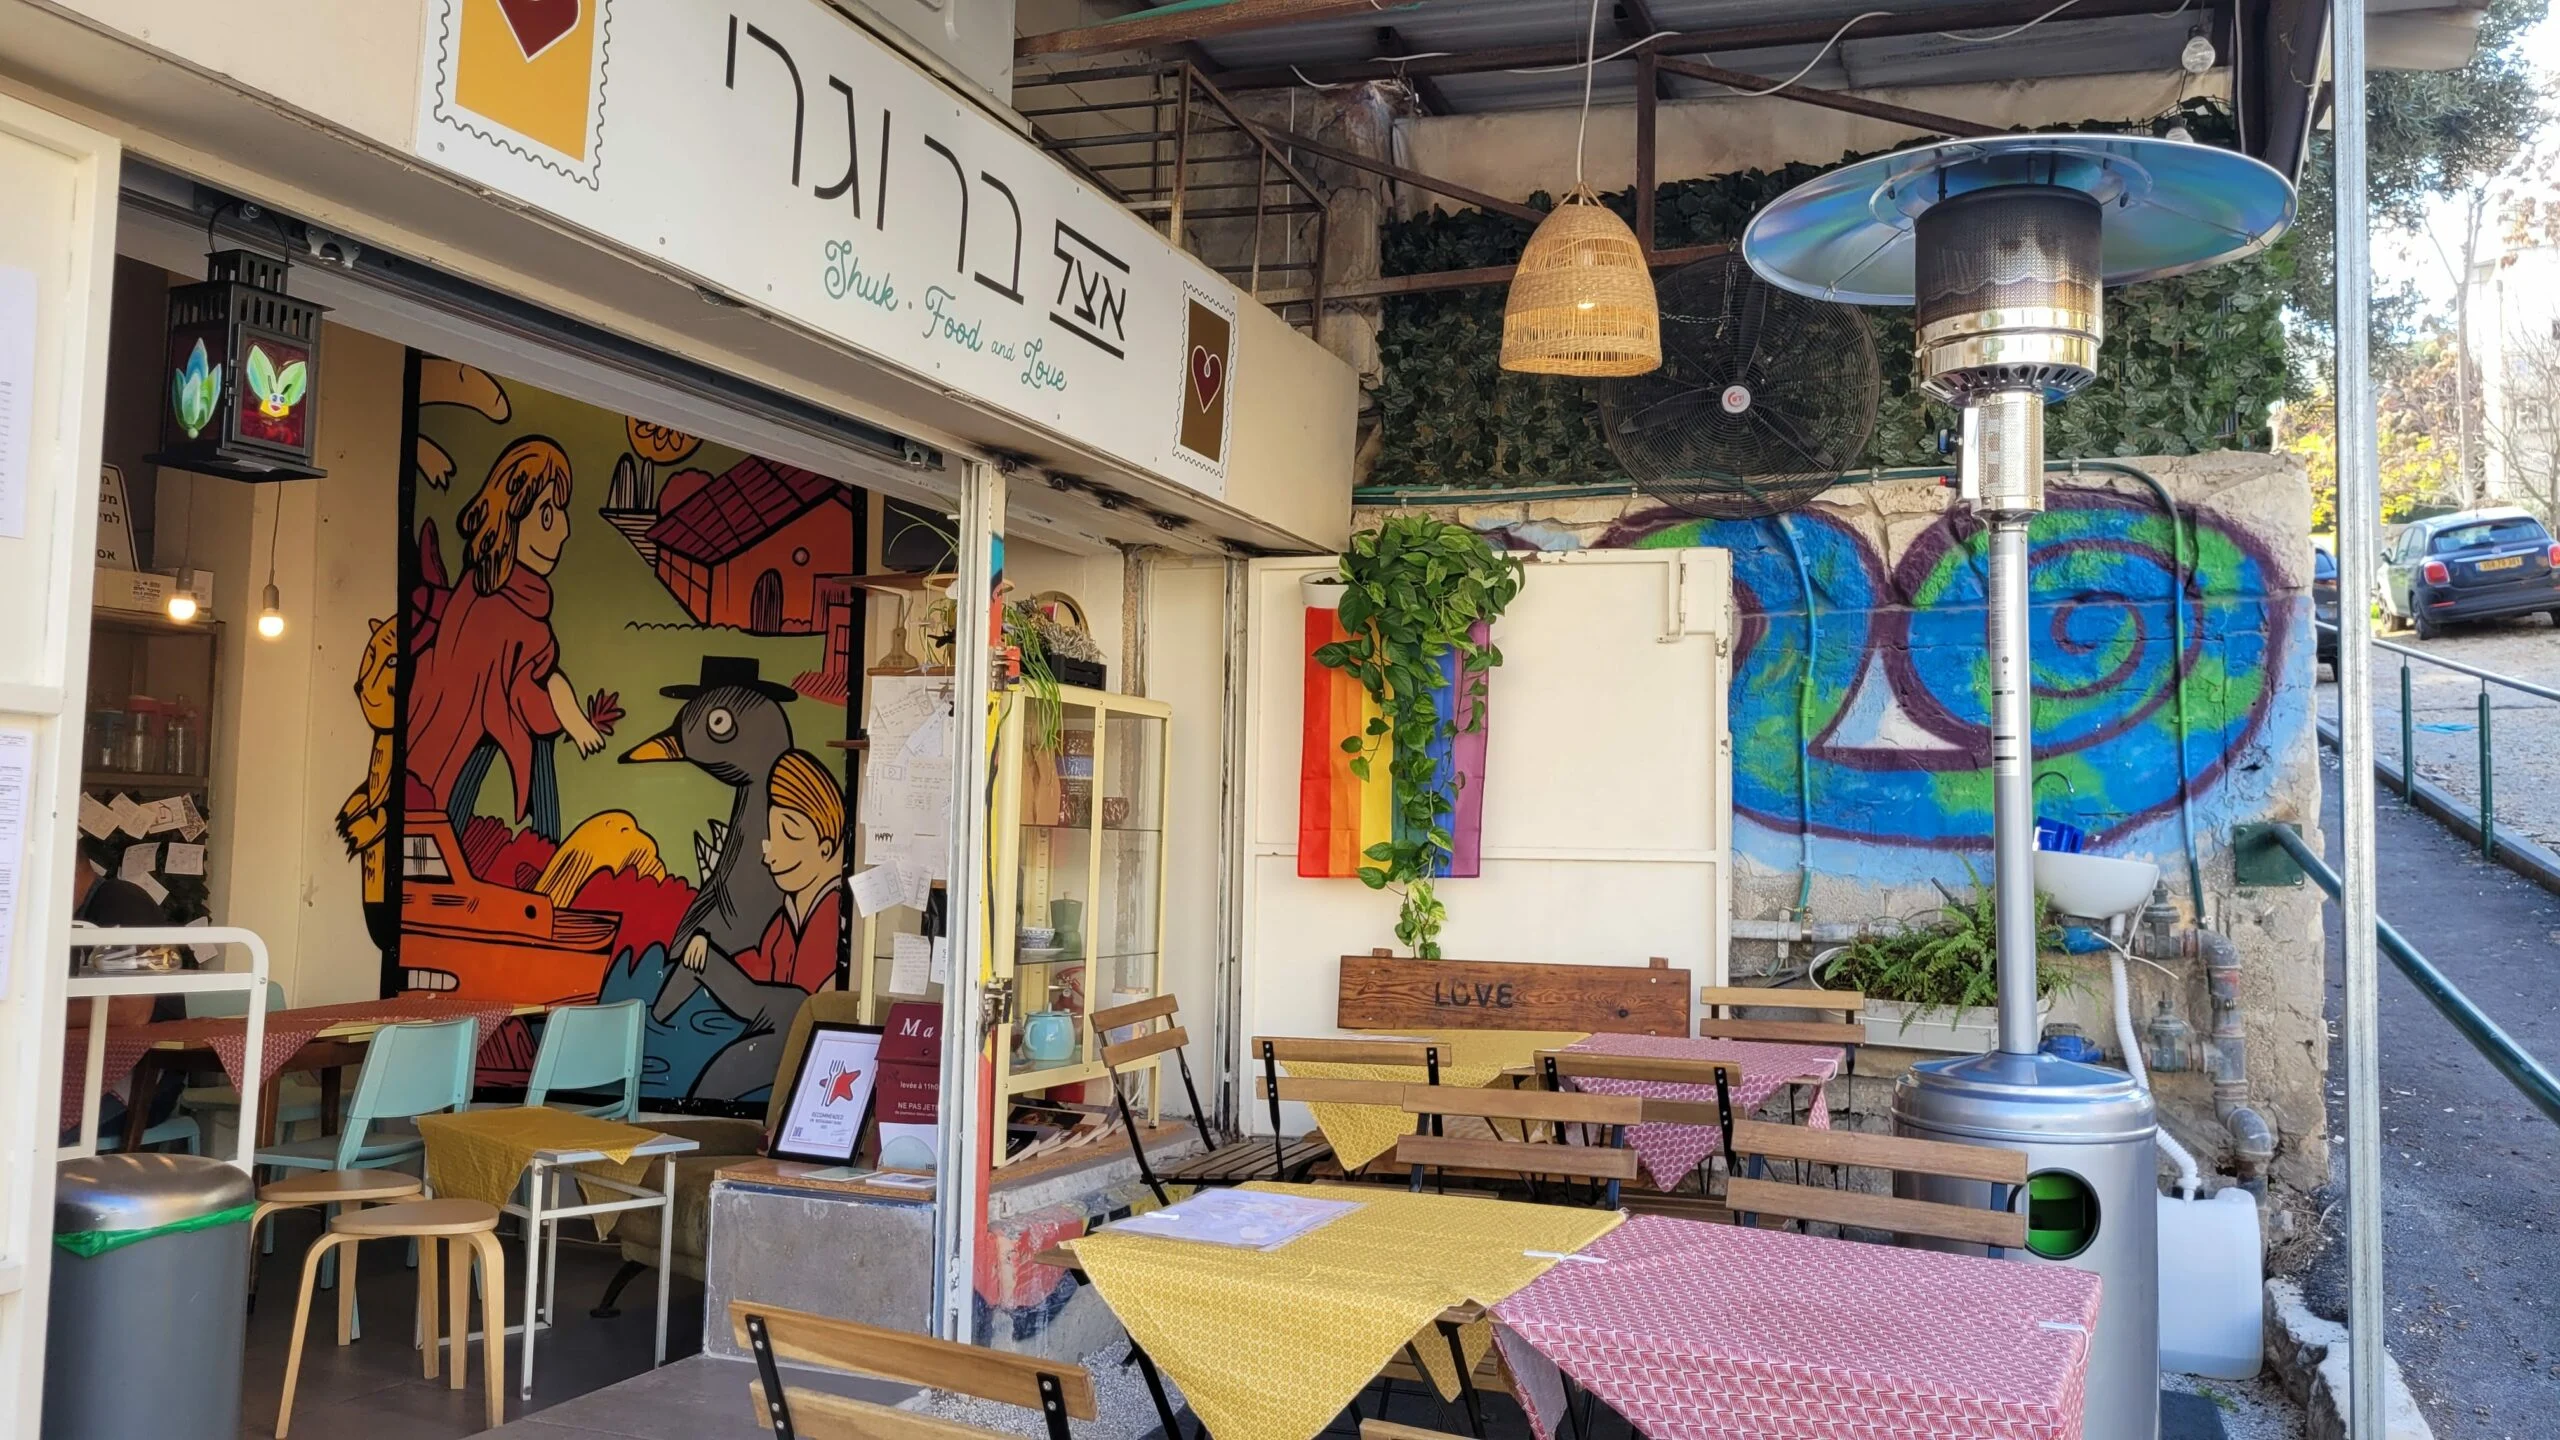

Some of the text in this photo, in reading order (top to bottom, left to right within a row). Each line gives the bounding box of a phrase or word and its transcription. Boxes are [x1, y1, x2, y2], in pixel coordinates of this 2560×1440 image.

[726, 13, 1130, 355] אצל ברוגרי
[825, 239, 1067, 392] Shuk Food and Love
[875, 832, 894, 843] HAPPY
[1435, 982, 1514, 1008] LOVE
[897, 1101, 908, 1109] NE
[909, 1102, 922, 1110] PAS
